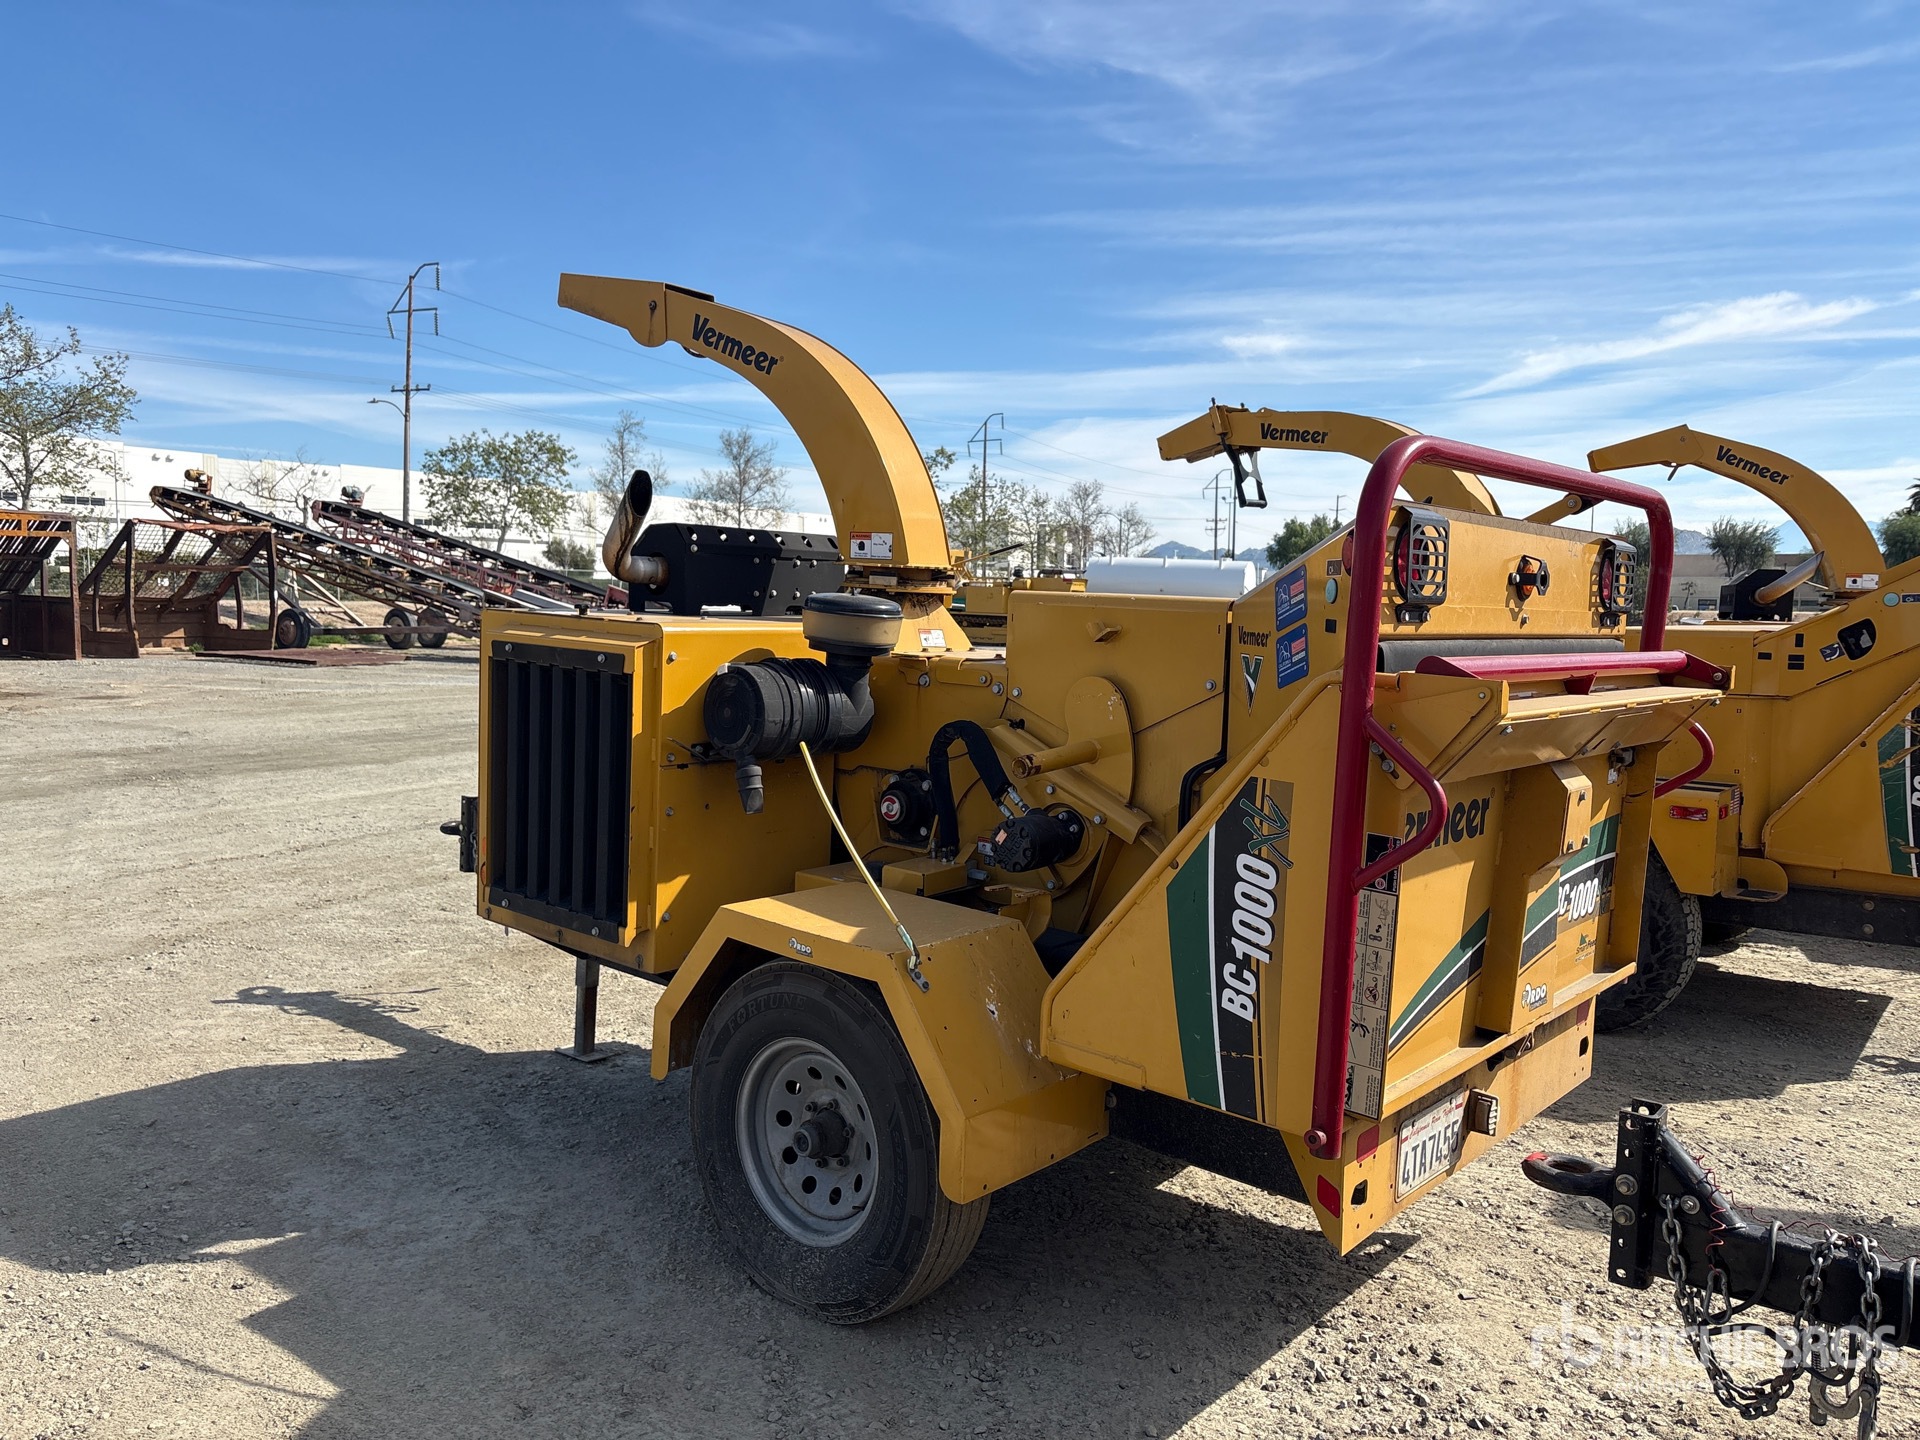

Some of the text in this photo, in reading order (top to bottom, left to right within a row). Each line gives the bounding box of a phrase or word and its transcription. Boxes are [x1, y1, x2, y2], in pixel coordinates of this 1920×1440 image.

[692, 313, 779, 376] Vermeer
[1260, 422, 1329, 444] Vermeer
[1716, 444, 1790, 485] Vermeer
[1238, 625, 1270, 648] Vermeer
[727, 992, 808, 1036] FORTUNE
[1402, 1118, 1460, 1187] 4TA7455
